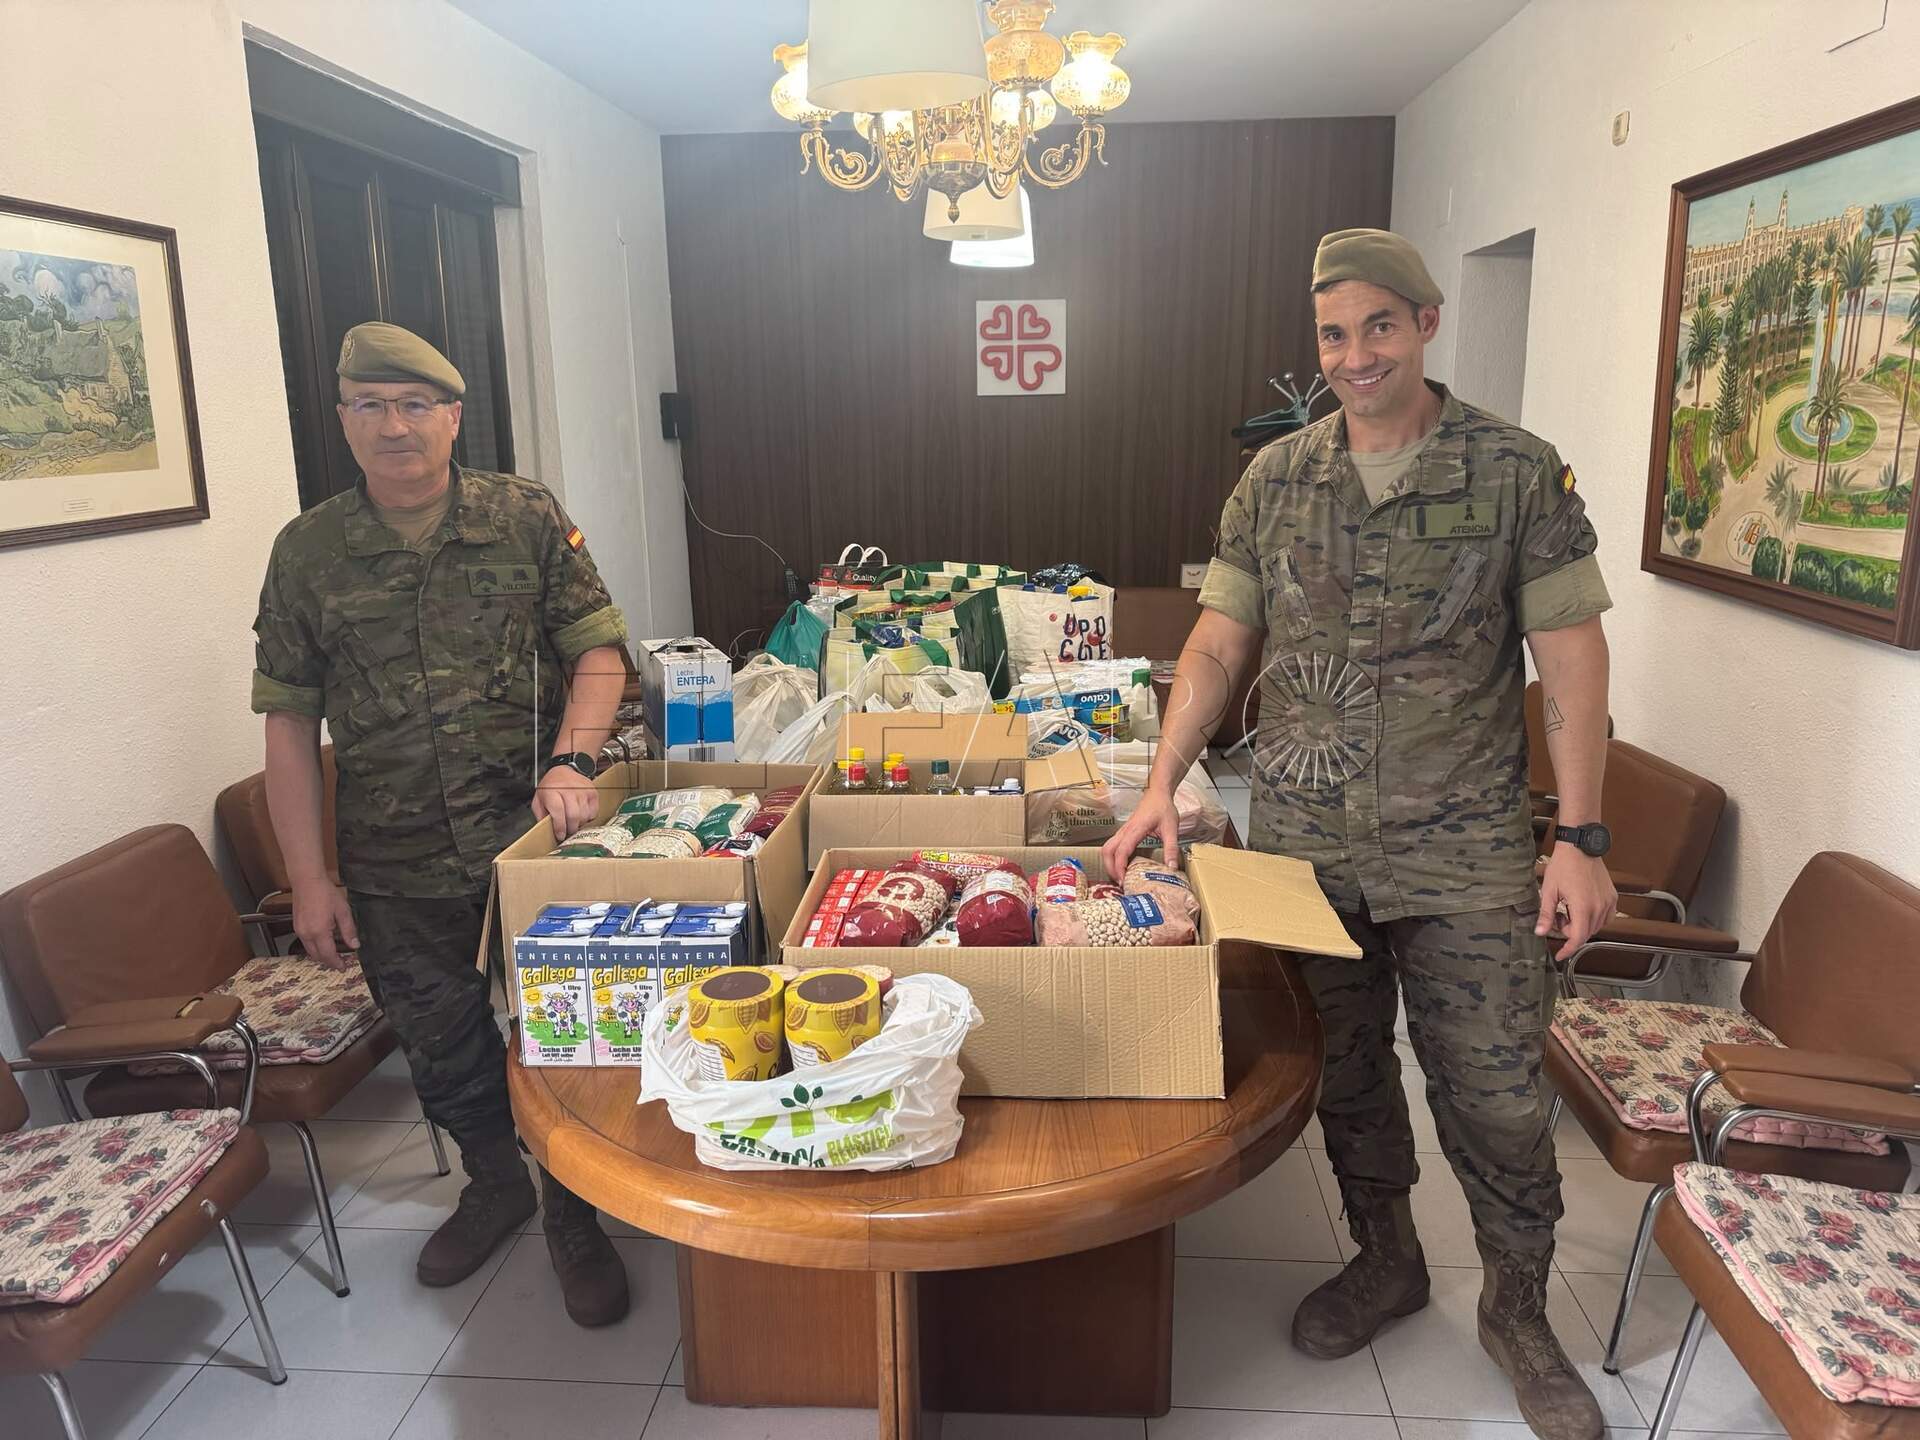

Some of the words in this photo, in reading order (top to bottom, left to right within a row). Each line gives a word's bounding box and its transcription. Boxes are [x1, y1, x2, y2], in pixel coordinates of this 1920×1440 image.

[1450, 525, 1490, 535] ATENCIA
[852, 573, 877, 582] Quality
[677, 675, 716, 687] ENTERA
[1080, 693, 1111, 704] Calvo
[517, 952, 583, 961] ENTERA
[588, 952, 655, 961] ENTERA
[660, 951, 728, 961] ENTERA
[522, 964, 577, 986] Gallega
[592, 963, 648, 986] Gallega
